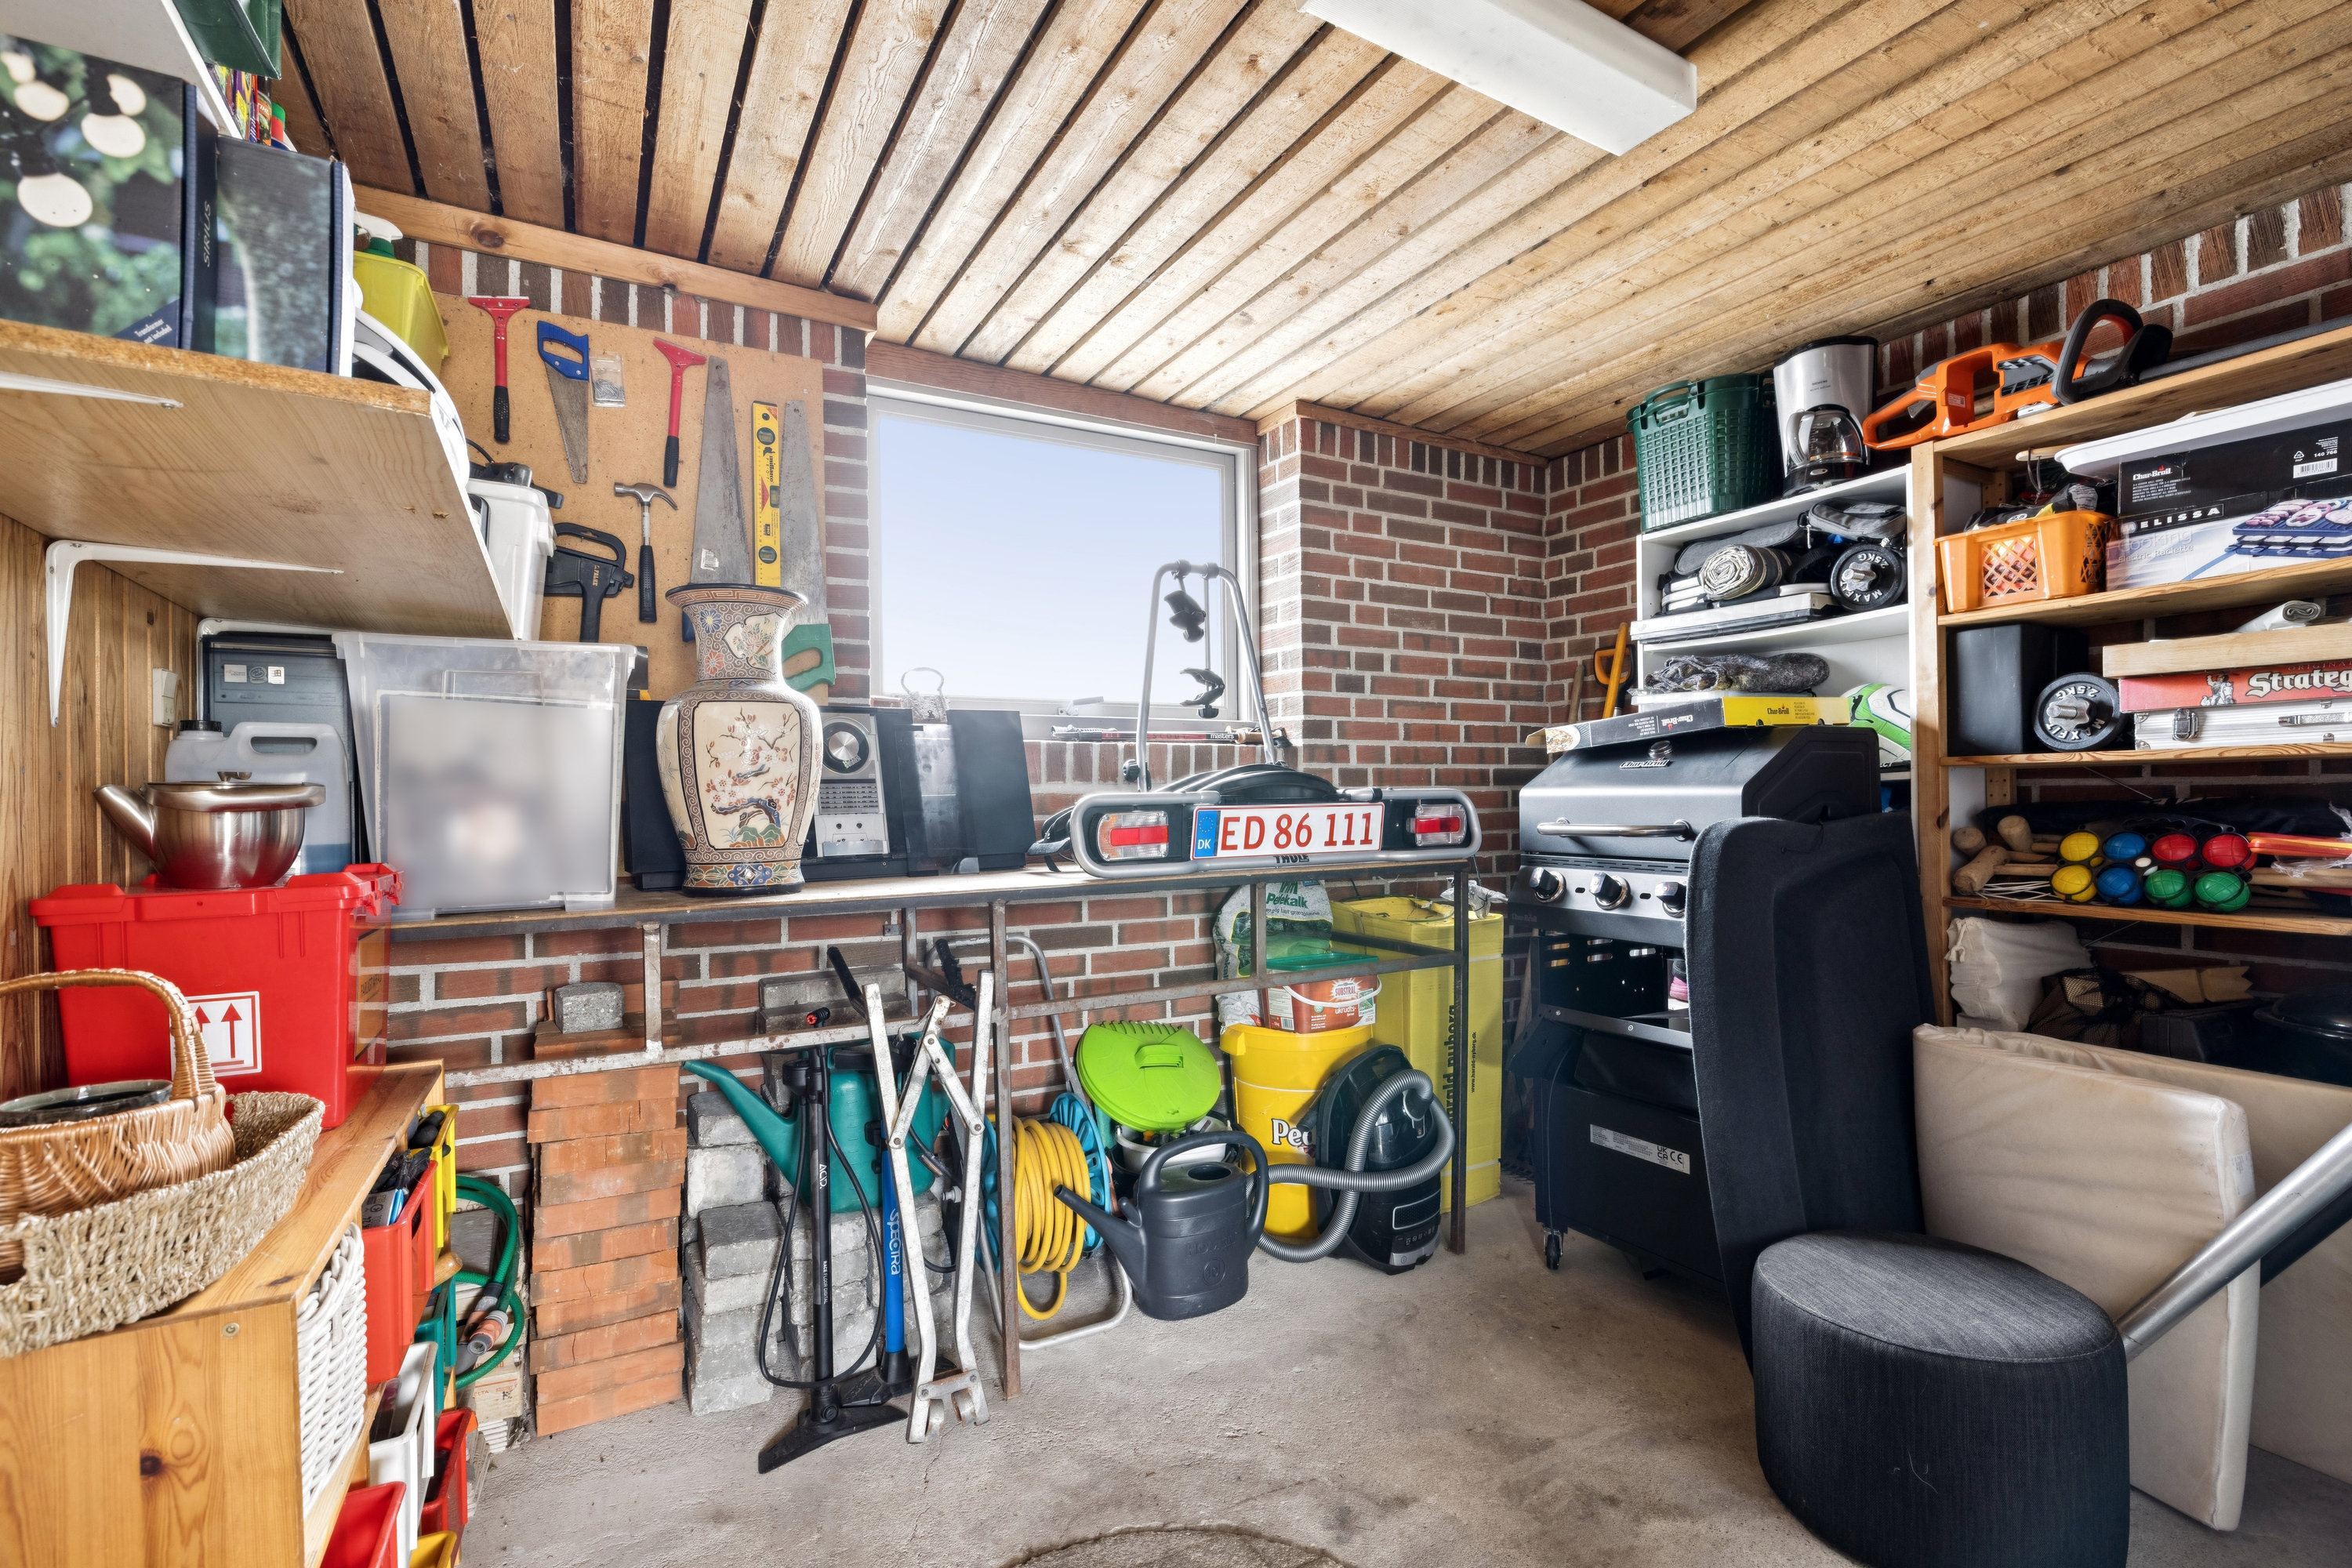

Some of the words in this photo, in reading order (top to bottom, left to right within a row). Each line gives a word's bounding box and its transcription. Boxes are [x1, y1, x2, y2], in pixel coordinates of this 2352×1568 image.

[256, 102, 270, 115] TIHL
[2132, 468, 2172, 481] Char-Broil
[2140, 507, 2220, 528] ELISSA
[2118, 553, 2152, 563] Electric
[2154, 545, 2194, 557] Raclette
[1197, 839, 1211, 850] DK
[1221, 816, 1266, 851] ED
[1274, 812, 1312, 849] 86
[1323, 812, 1373, 847] 111
[1273, 854, 1310, 864] THULE
[1335, 988, 1356, 996] SUBSTRAL
[1657, 1145, 1668, 1154] UK
